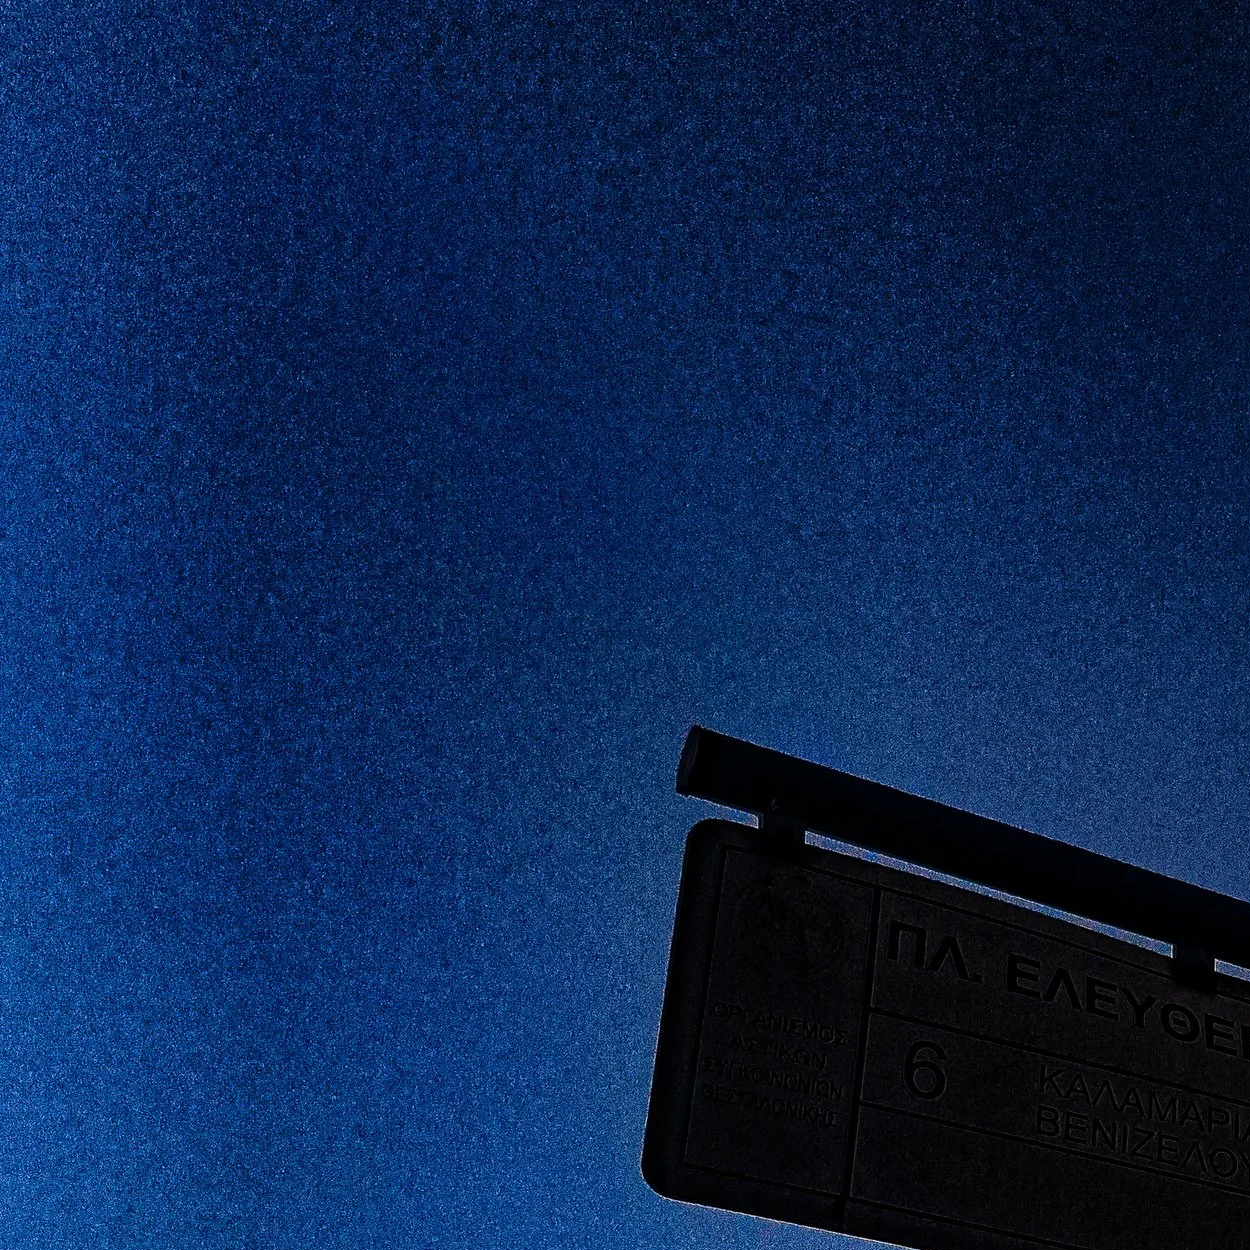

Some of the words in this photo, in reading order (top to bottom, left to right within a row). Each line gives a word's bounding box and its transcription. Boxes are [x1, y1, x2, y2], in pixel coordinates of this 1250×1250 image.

[886, 920, 981, 983] ΠΛ.
[711, 1001, 848, 1046] ΟΡΓΑΝΙΣΜΟΣ
[729, 1033, 827, 1071] ΑΣΤΙΚΩΝ
[903, 1040, 947, 1099] 6
[703, 1056, 845, 1102] ΣΥΓΚΟΙΝΩΝΙΩΝ
[701, 1082, 839, 1127] ΘΕΣΣΑΛΟΝΙΚΗΣ
